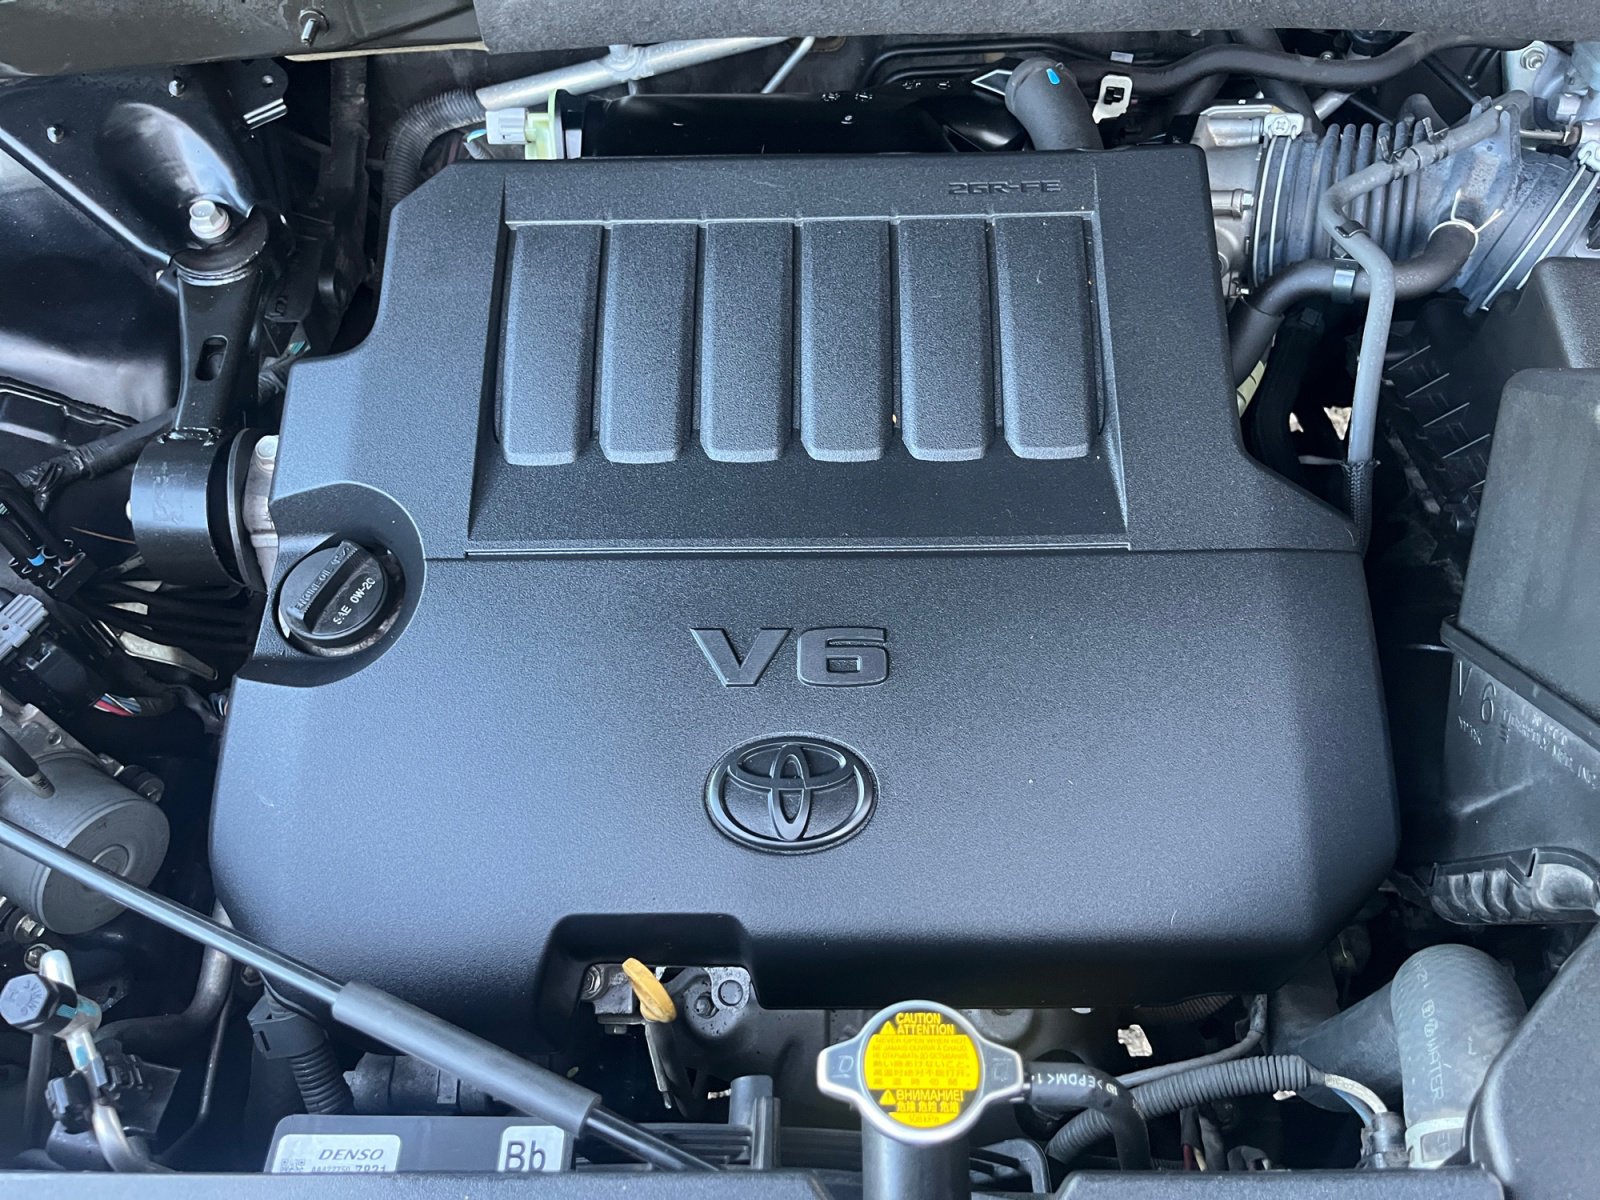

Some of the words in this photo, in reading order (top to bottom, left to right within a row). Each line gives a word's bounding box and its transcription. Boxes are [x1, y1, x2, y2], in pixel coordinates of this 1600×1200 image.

[948, 181, 1061, 195] 2GR-FE
[333, 605, 352, 625] SAE
[350, 577, 376, 604] 0W-20
[689, 626, 890, 688] V6
[895, 1012, 941, 1024] CAUTION
[897, 1024, 955, 1034] ATTENTION
[896, 1089, 964, 1102] ВНИМАНИЕ!
[318, 1148, 385, 1161] DENSO
[505, 1140, 546, 1172] Bb
